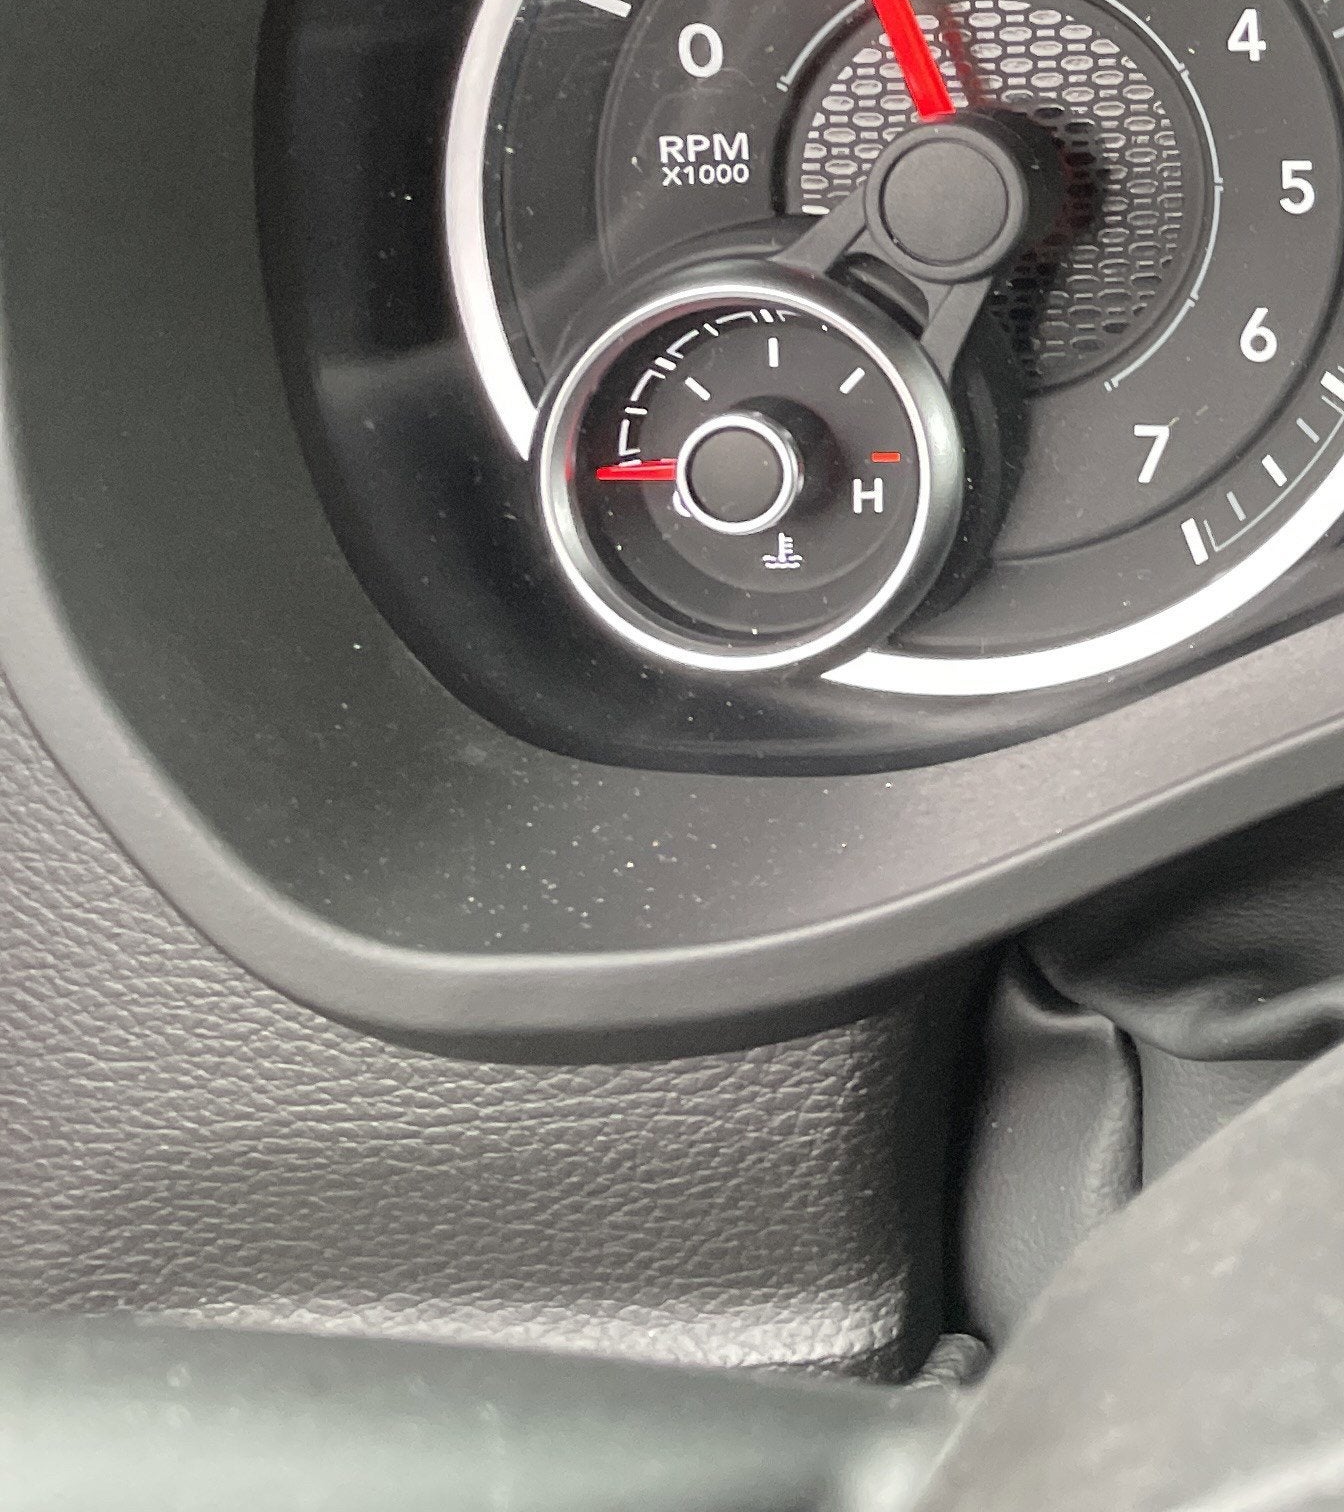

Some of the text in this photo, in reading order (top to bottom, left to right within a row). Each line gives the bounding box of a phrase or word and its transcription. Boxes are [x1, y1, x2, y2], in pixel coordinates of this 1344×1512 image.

[679, 23, 723, 78] 0
[1228, 9, 1267, 61] 4
[659, 132, 750, 162] RPM
[661, 163, 750, 186] X1000
[1279, 160, 1315, 214] 5
[1240, 308, 1277, 363] 6
[1134, 424, 1170, 483] 7
[853, 478, 884, 513] H
